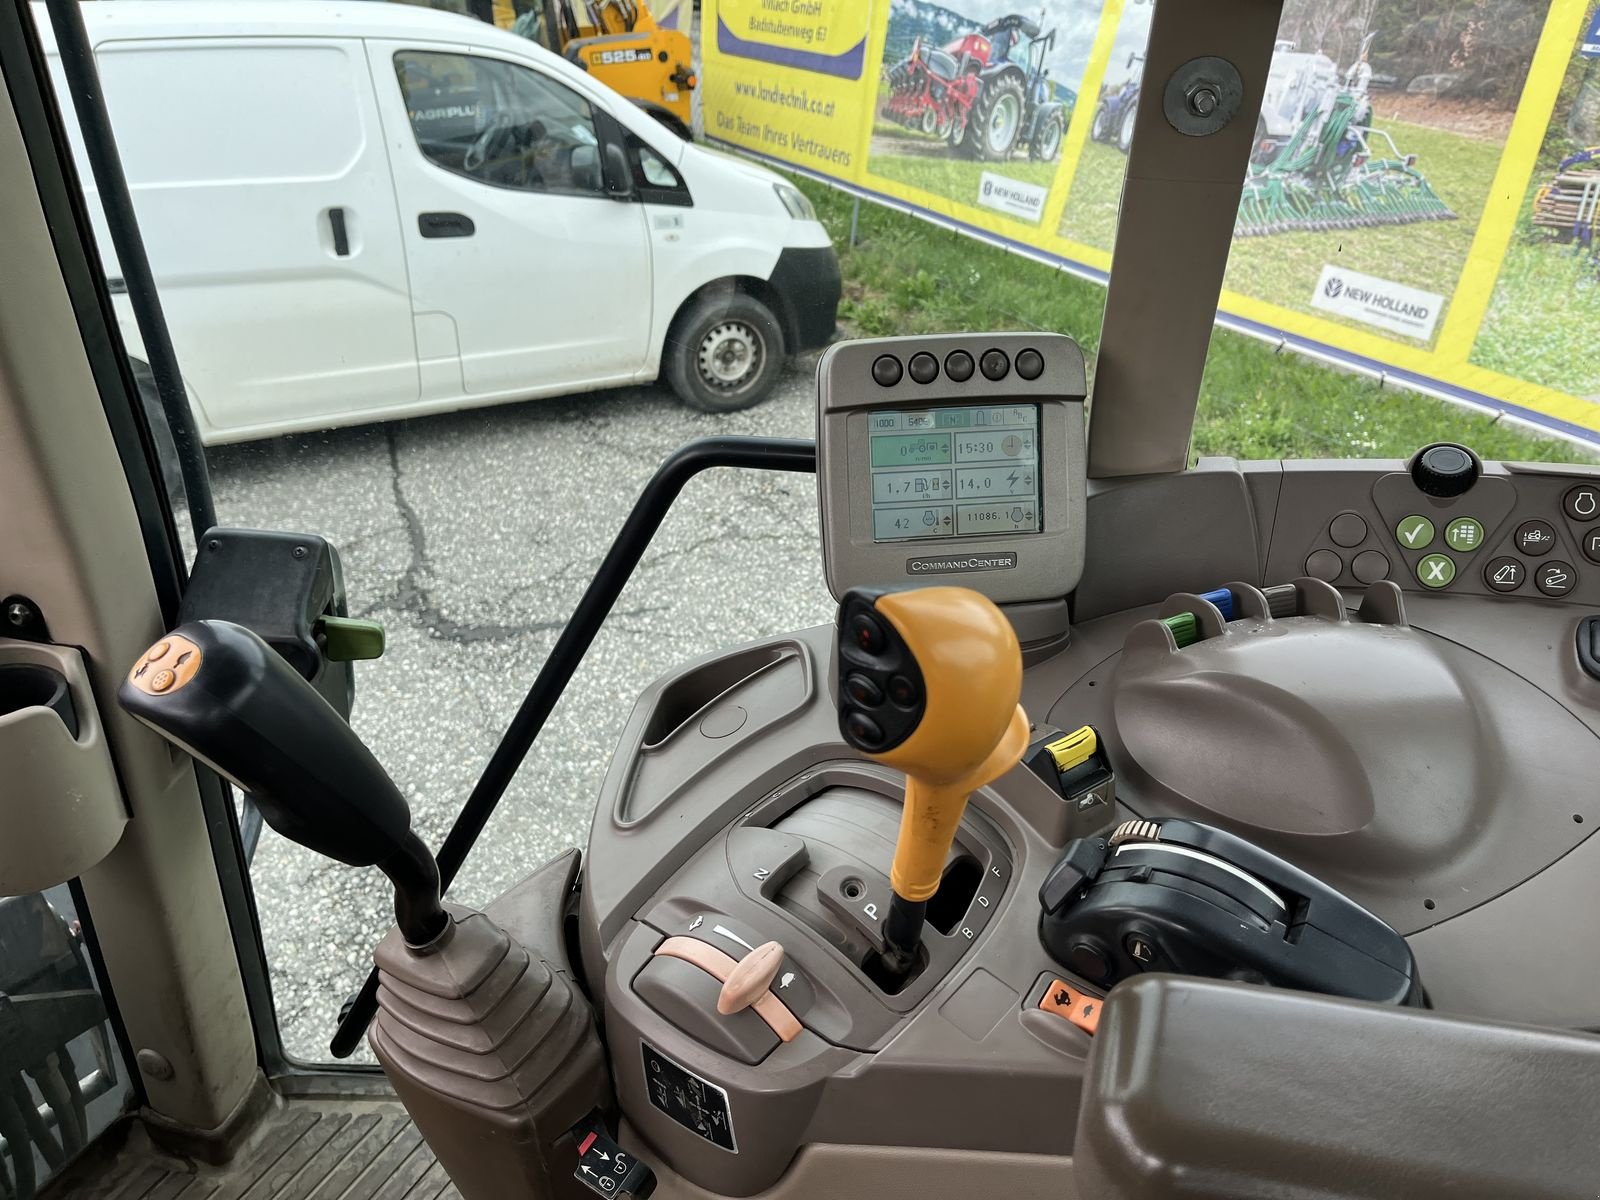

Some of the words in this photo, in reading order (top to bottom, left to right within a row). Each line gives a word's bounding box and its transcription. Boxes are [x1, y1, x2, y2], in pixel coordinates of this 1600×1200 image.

[790, 0, 822, 16] GmbH
[735, 80, 835, 117] www.landtechnik.co.at
[716, 111, 734, 130] Das
[736, 115, 761, 138] Team
[762, 124, 788, 147] Ihres
[791, 131, 851, 167] Vertrauens
[993, 186, 1010, 199] NEW
[1009, 191, 1041, 208] HOLLAND
[1343, 285, 1372, 303] NEW
[1371, 293, 1430, 320] HOLLAND
[875, 418, 895, 429] 1000
[958, 441, 994, 454] 15:30
[888, 481, 911, 494] 1.7
[960, 477, 991, 490] 14.0
[894, 518, 910, 529] 42
[991, 865, 1001, 878] F
[977, 896, 990, 908] D
[863, 903, 878, 921] P
[961, 927, 974, 940] B
